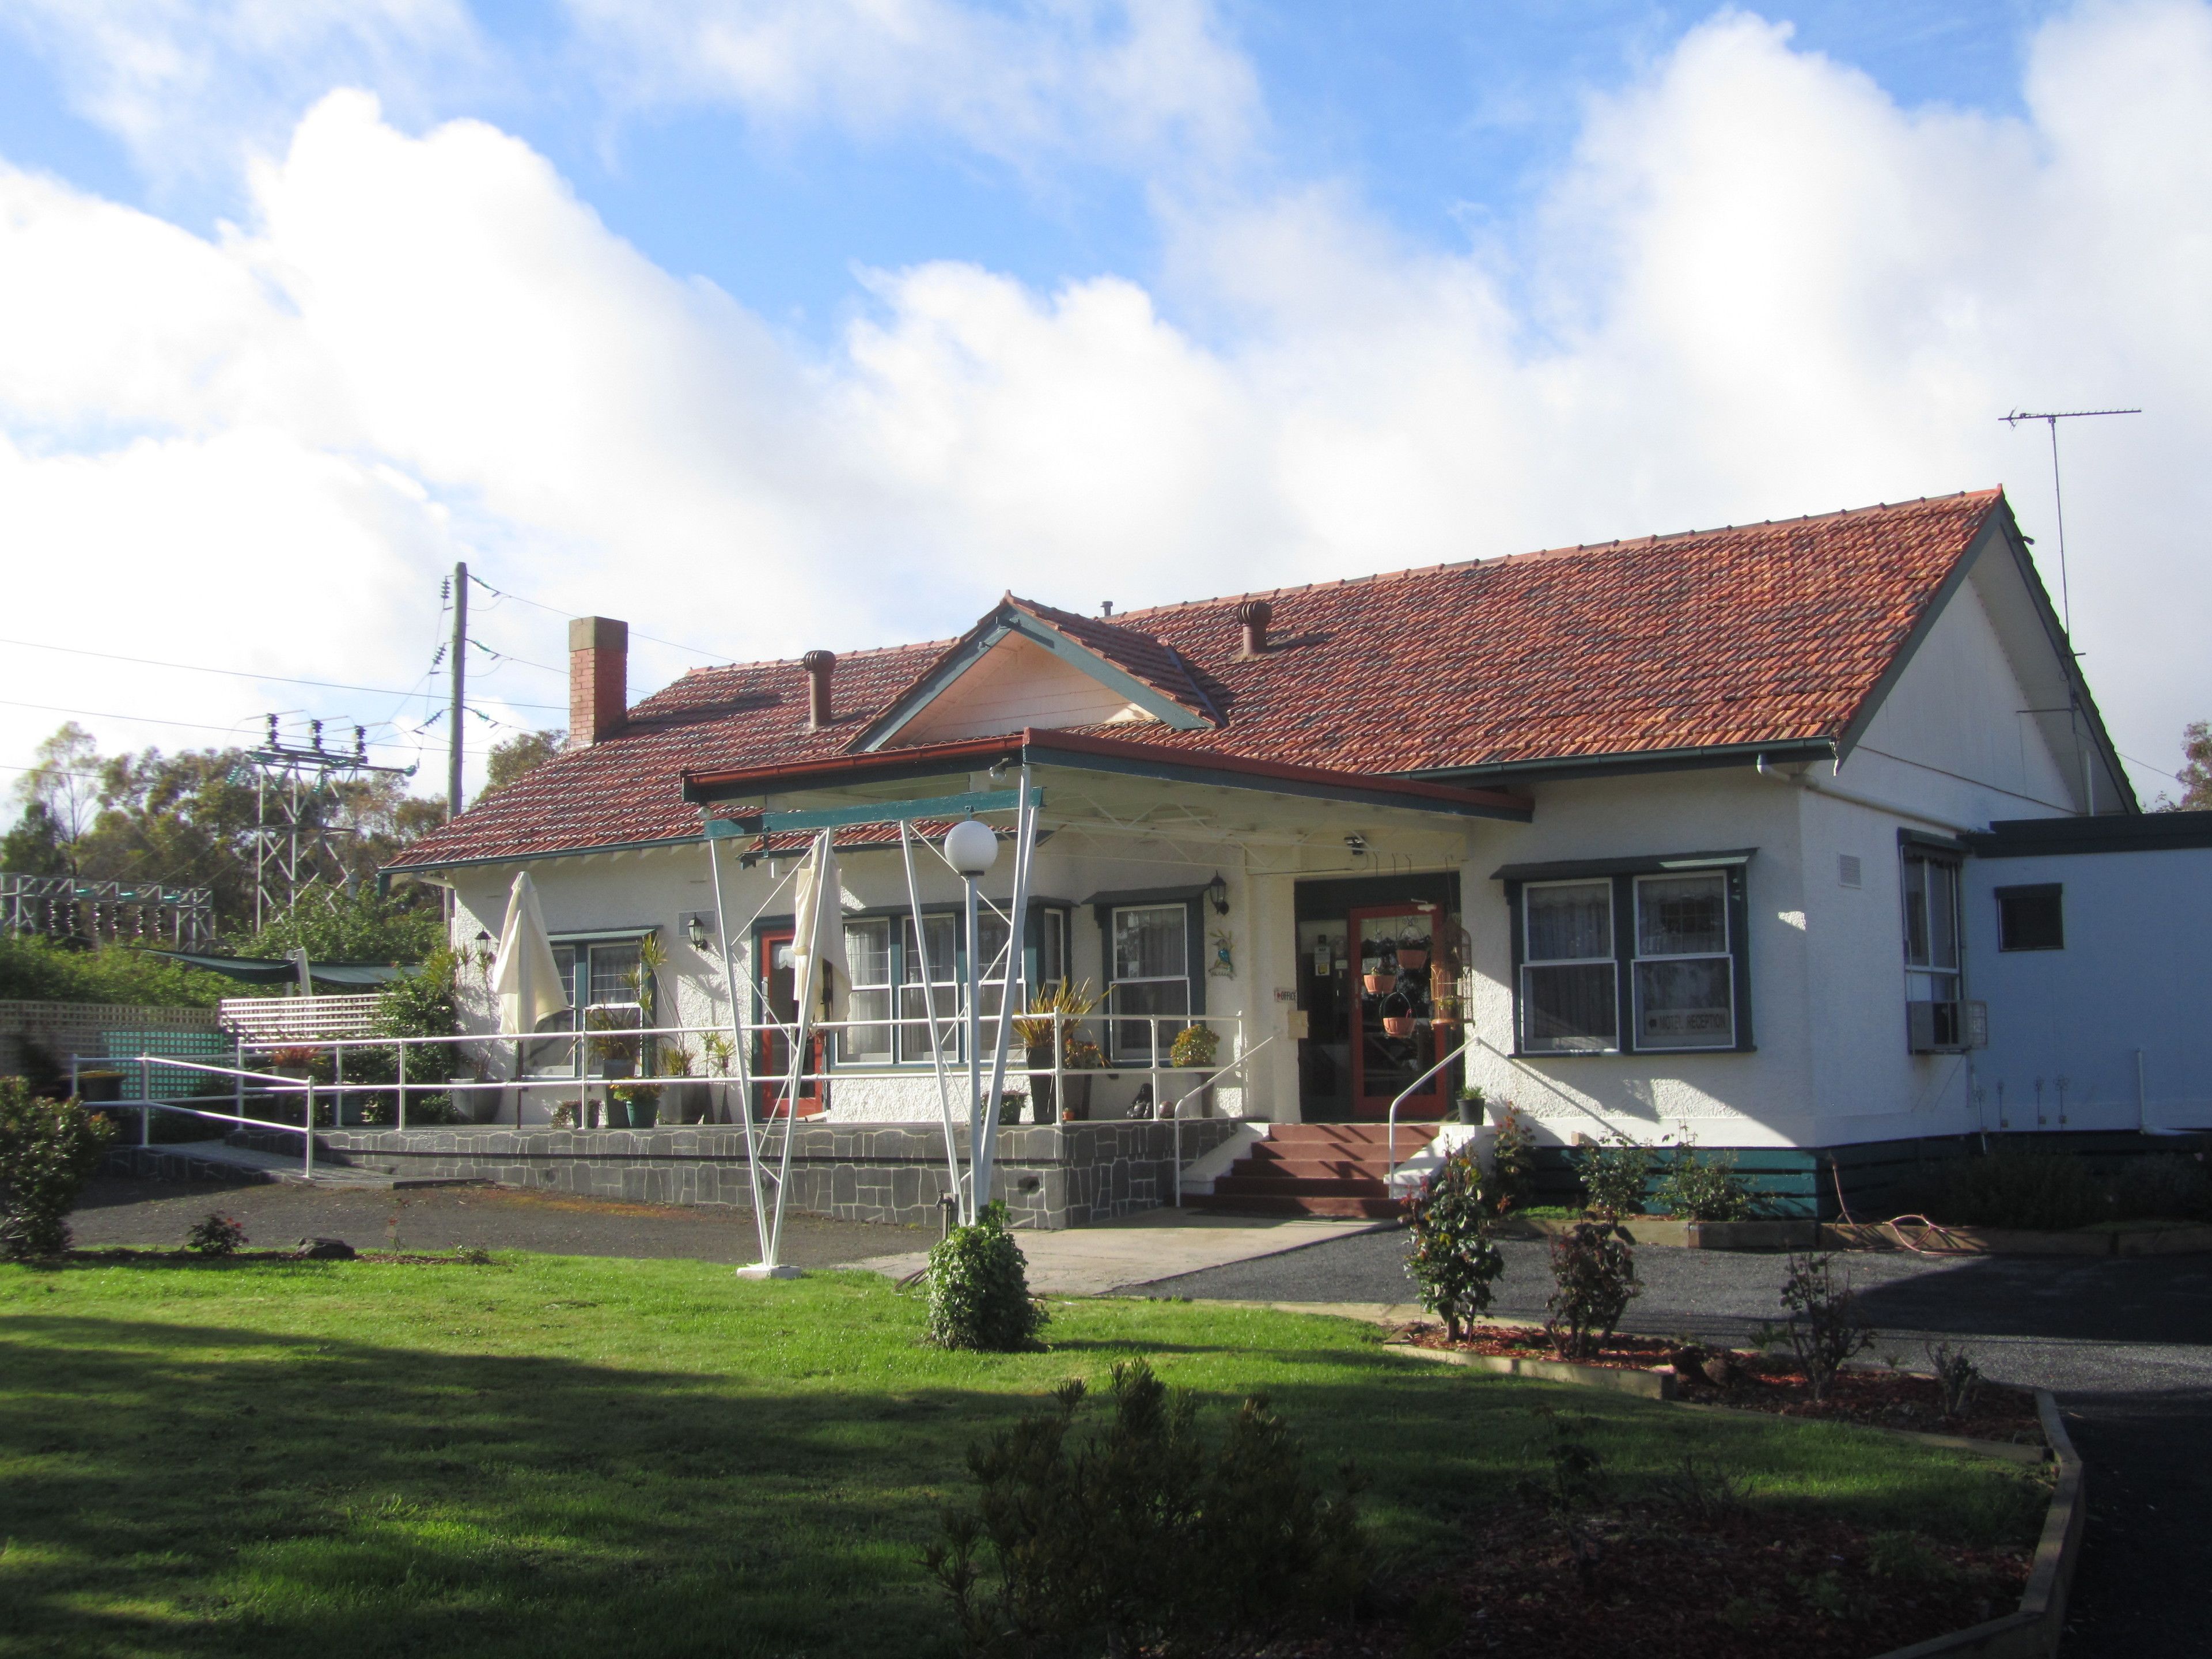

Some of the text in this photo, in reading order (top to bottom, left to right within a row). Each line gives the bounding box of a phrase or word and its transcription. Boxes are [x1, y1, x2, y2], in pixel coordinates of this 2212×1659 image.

[1281, 991, 1296, 1001] OFFICE
[1659, 1013, 1726, 1029] MOTEL RECEPTION
